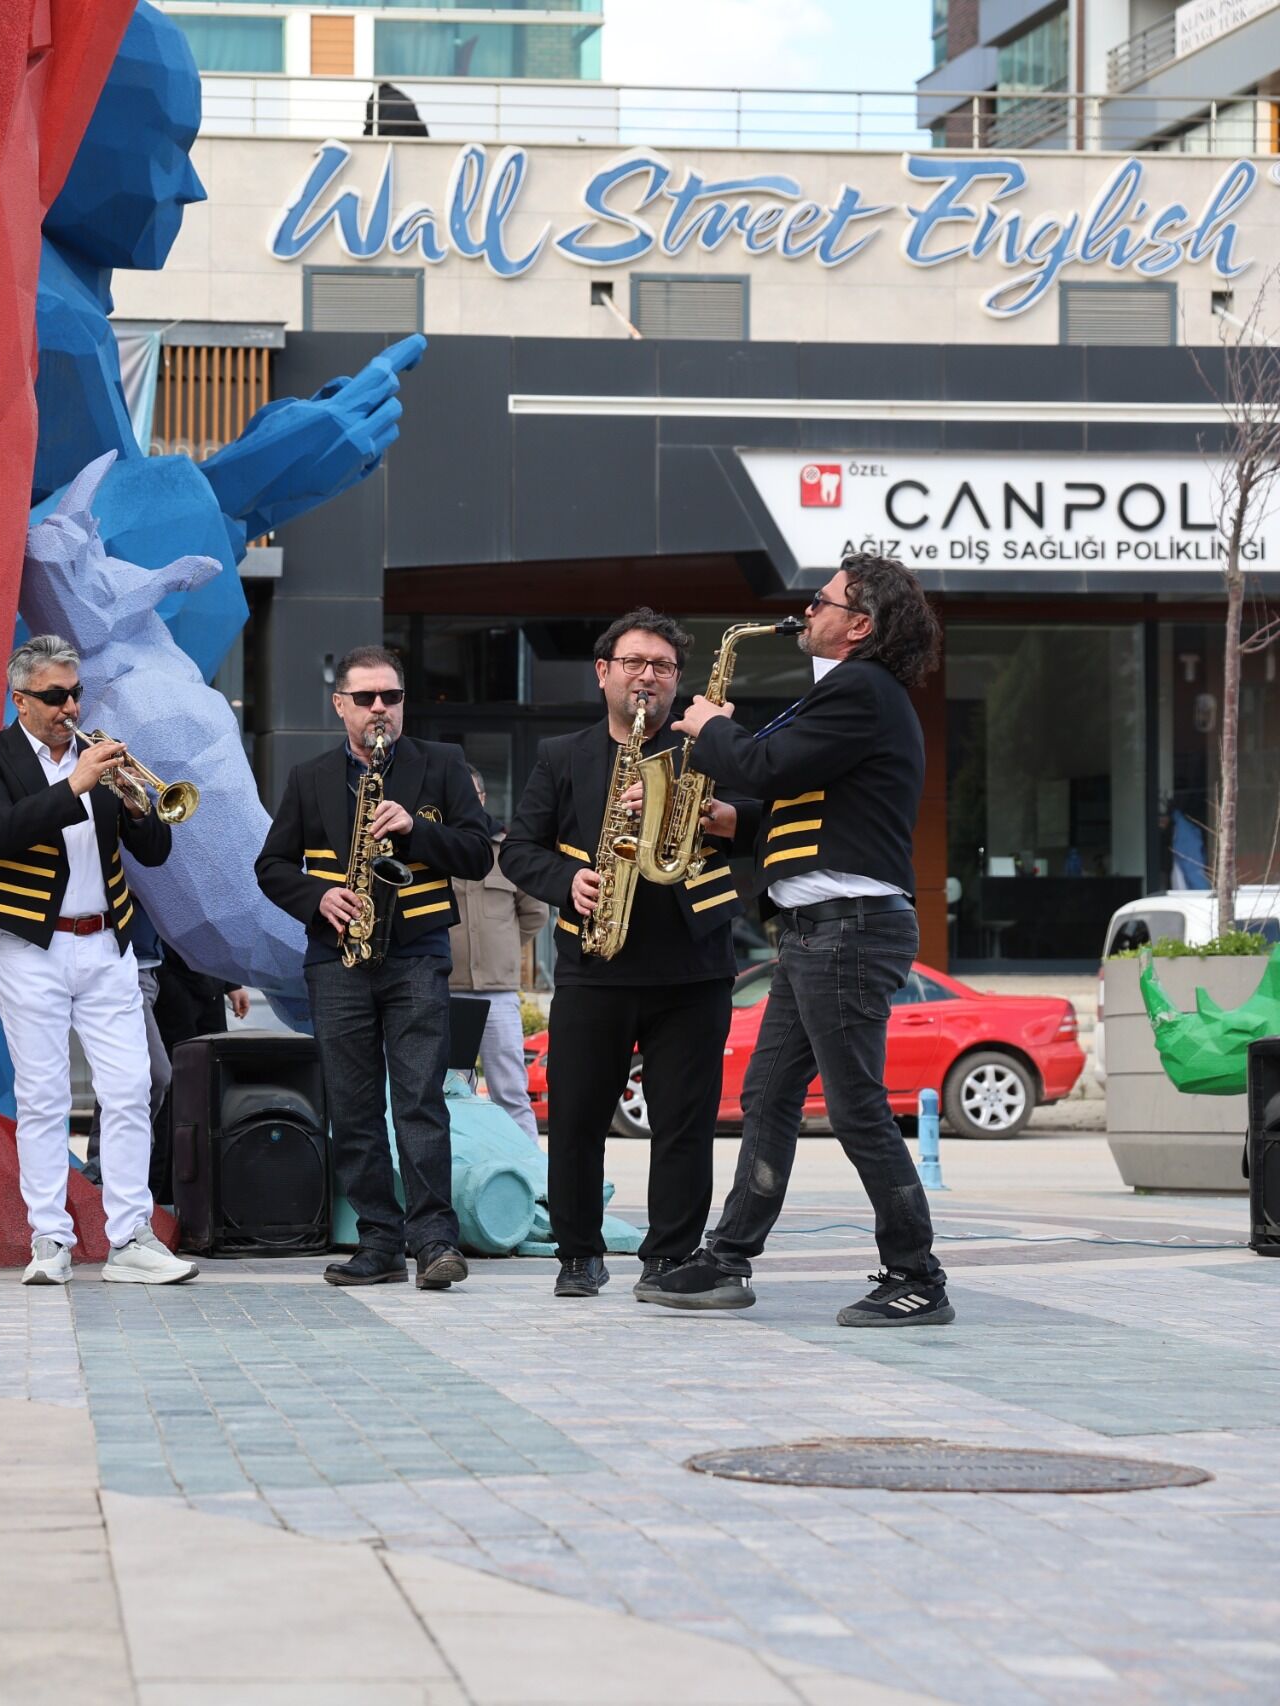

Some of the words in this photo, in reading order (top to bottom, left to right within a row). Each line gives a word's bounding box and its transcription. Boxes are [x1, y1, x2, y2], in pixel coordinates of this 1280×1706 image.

[268, 138, 551, 279] Wall
[553, 146, 896, 268] Street
[902, 152, 1257, 318] English
[849, 461, 888, 477] ÖZEL
[884, 479, 1218, 531] CANPOL
[840, 534, 902, 560] AĞIZ
[910, 544, 939, 559] ve
[950, 536, 990, 564] DİŞ
[1002, 535, 1106, 561] SAĞLIĞI
[1116, 536, 1266, 561] POLİKLİNĞİ
